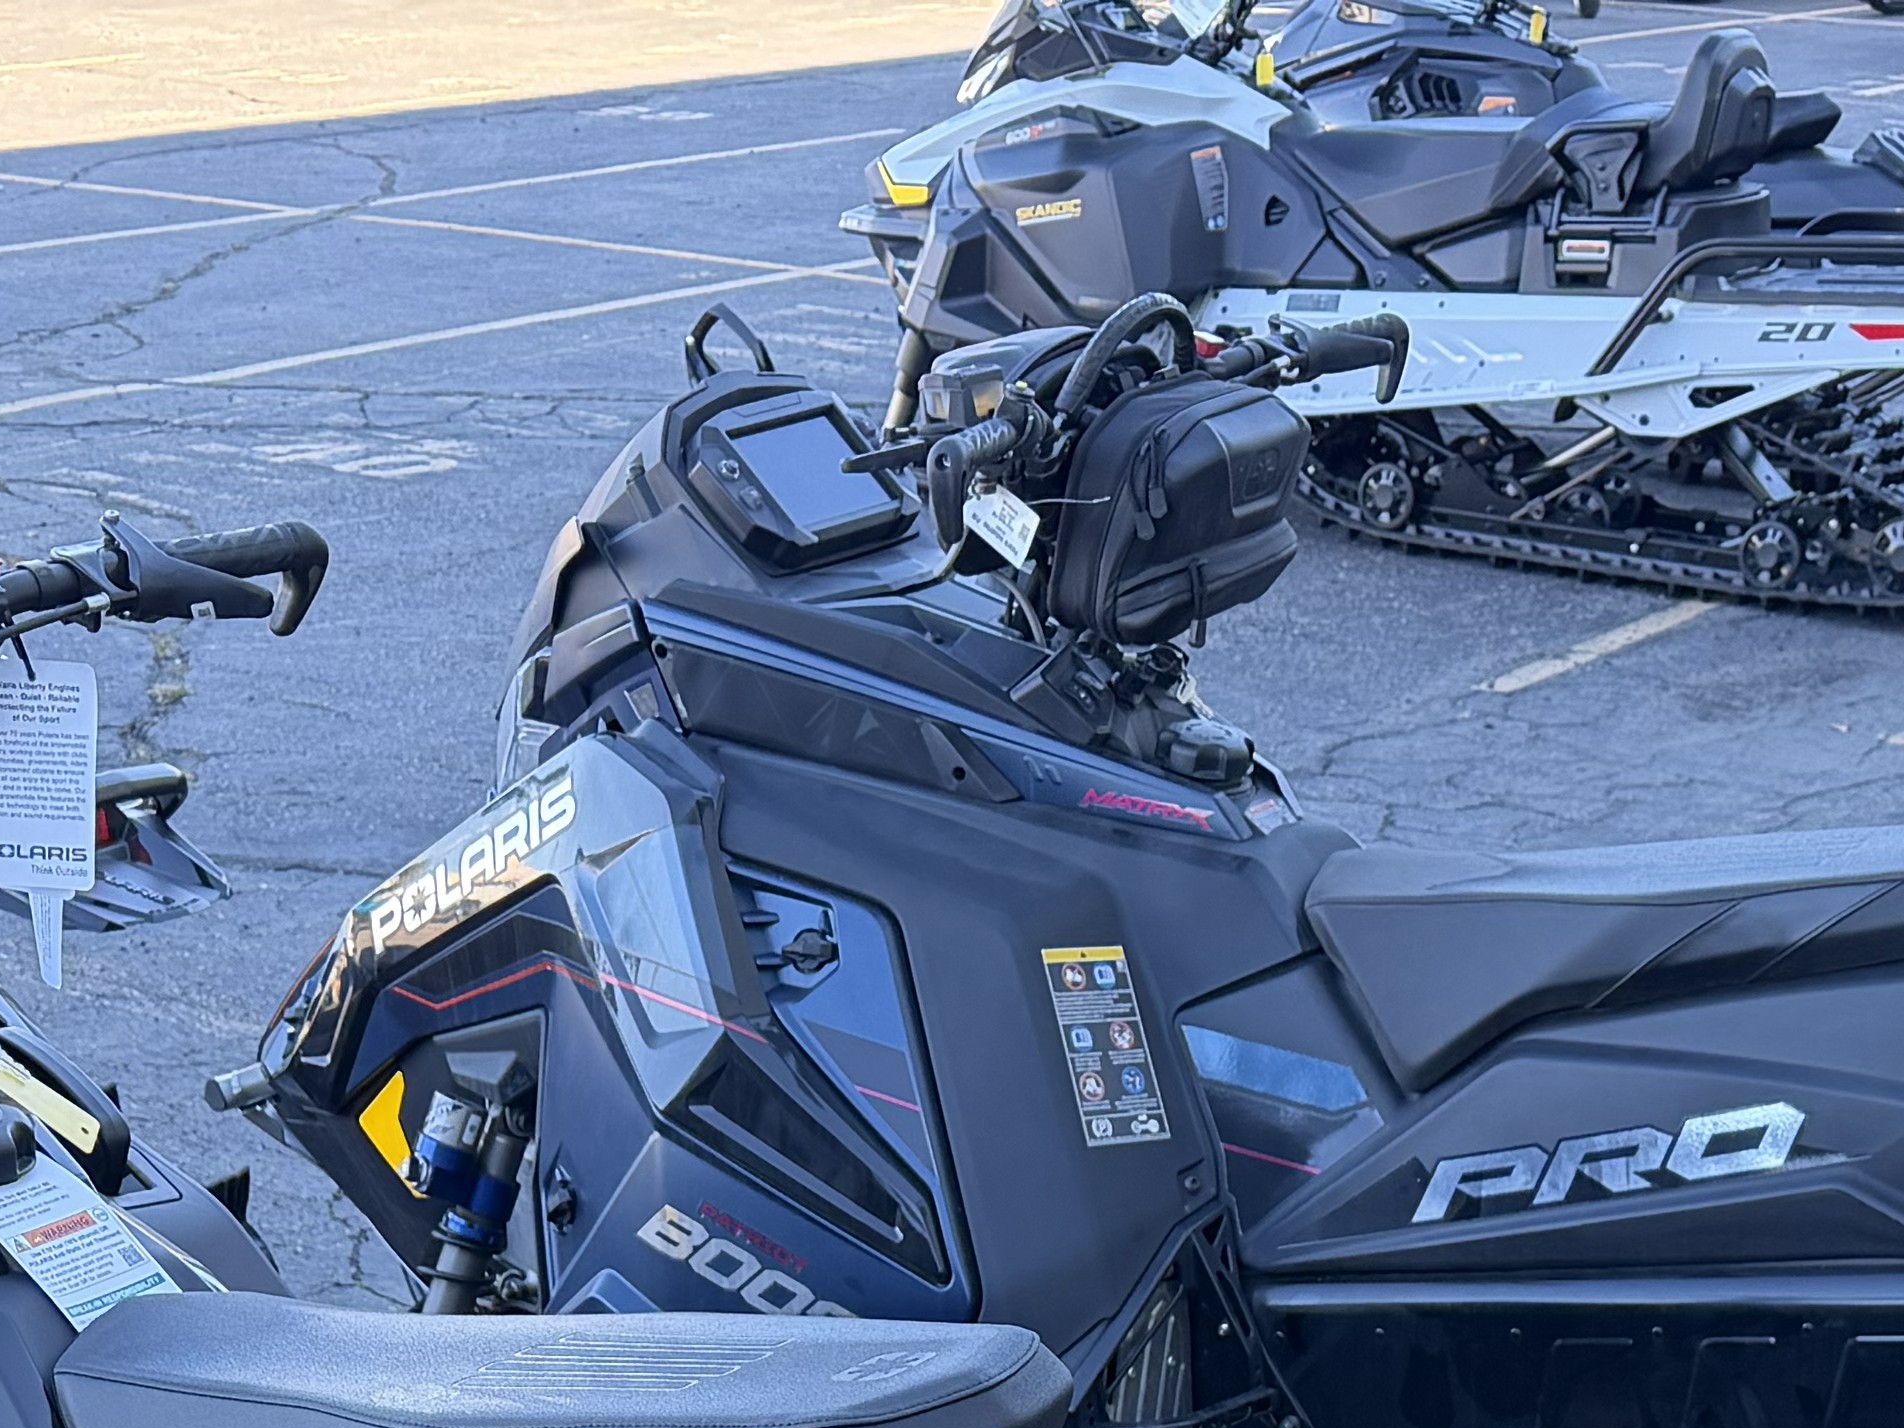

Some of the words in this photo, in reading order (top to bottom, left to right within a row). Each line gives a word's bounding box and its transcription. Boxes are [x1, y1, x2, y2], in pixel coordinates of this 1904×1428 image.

[1758, 322, 1837, 343] 20
[19, 682, 45, 691] Liberty
[48, 684, 80, 692] Engines
[21, 693, 41, 701] Quiet
[37, 703, 49, 712] the
[51, 705, 76, 713] Future
[39, 715, 60, 724] Sport
[1077, 787, 1216, 832] MATRYX
[31, 864, 53, 876] Think
[55, 864, 88, 877] Outside
[371, 776, 577, 956] POLARIS
[1391, 1101, 1807, 1225] PRO
[698, 1200, 809, 1274] PATRIOT
[637, 1203, 859, 1318] BOO
